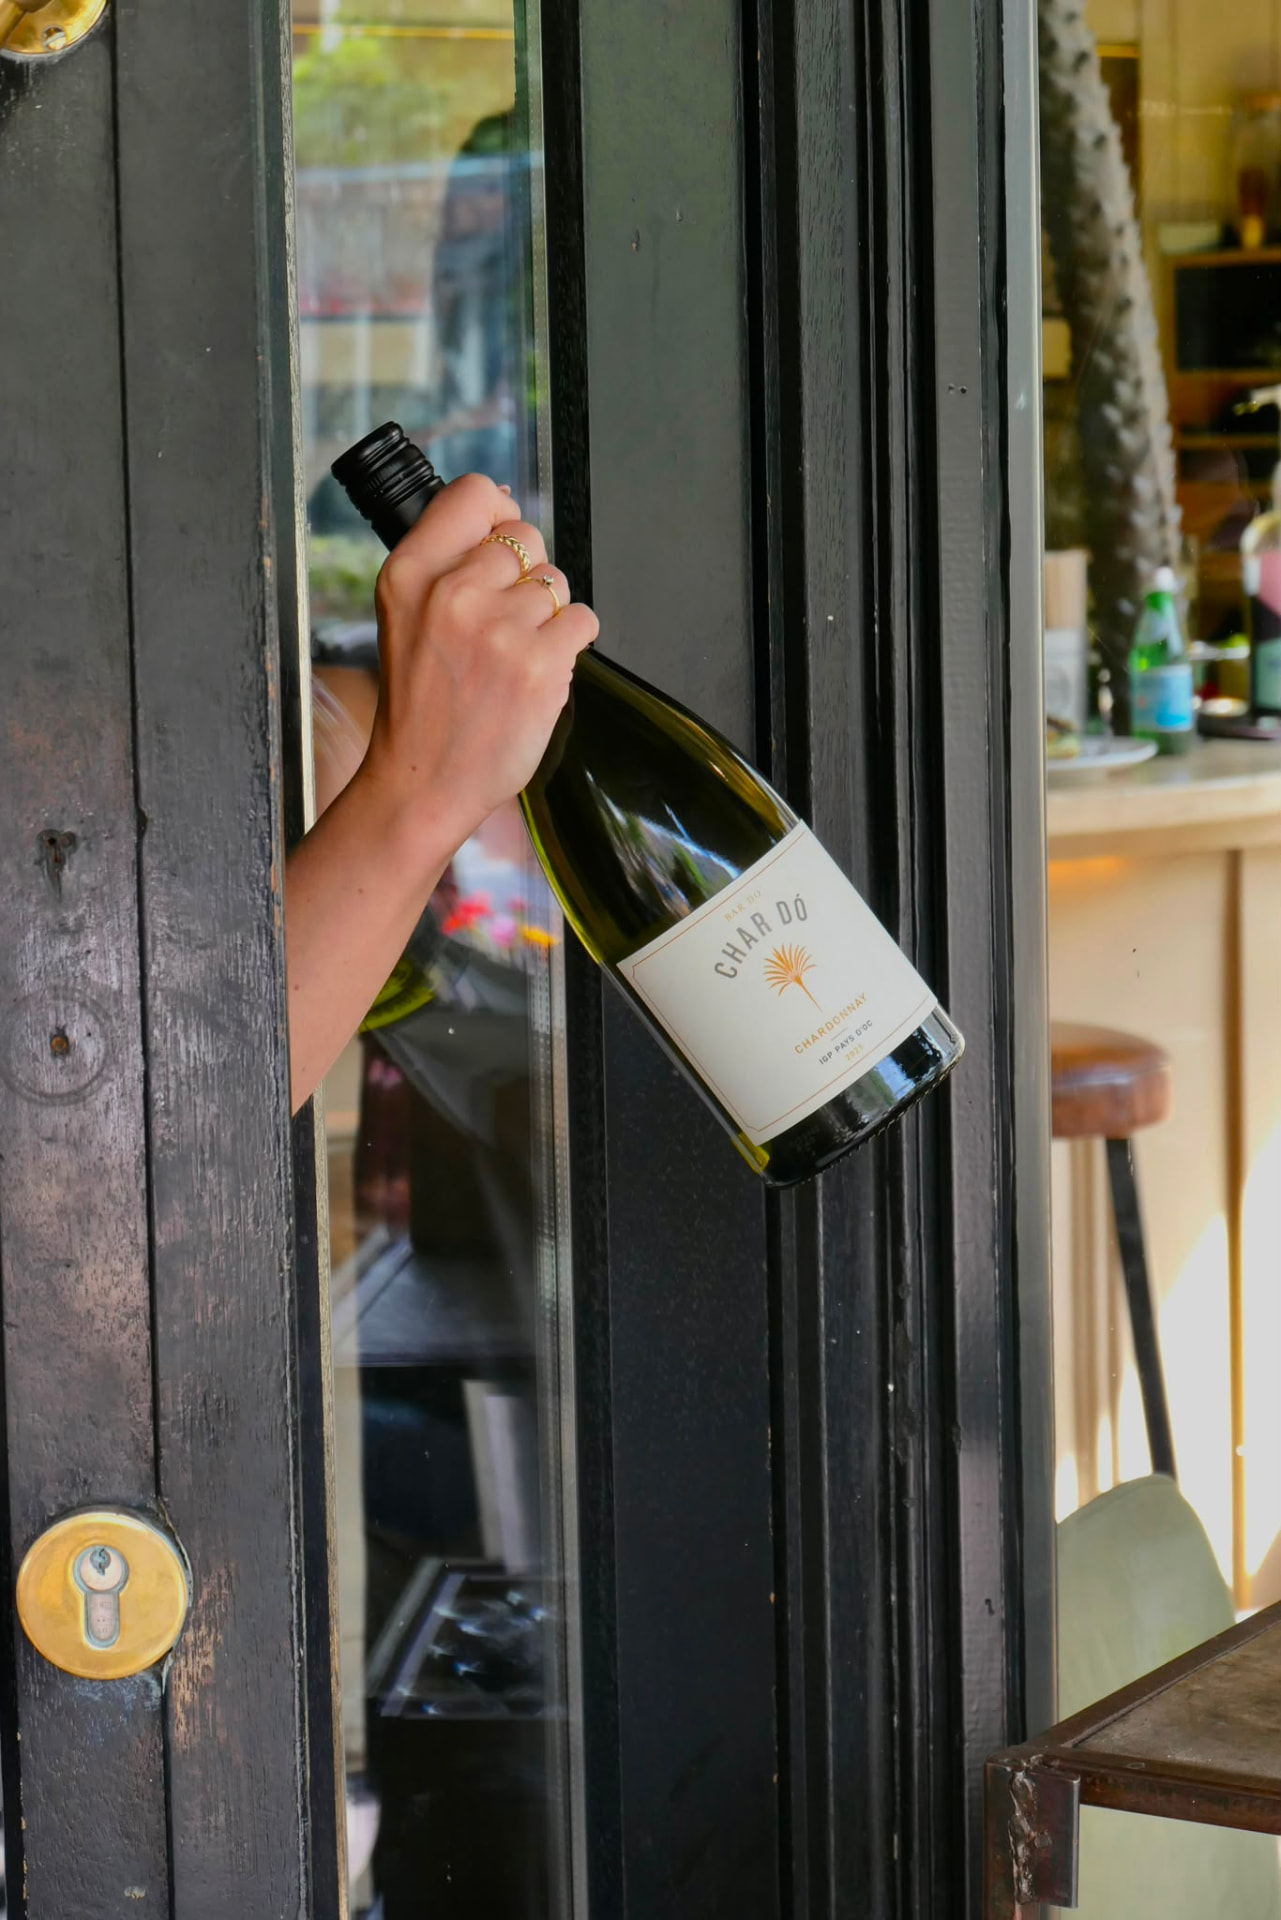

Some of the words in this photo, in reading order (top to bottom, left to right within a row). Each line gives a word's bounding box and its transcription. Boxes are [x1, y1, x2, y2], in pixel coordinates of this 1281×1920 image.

[714, 912, 773, 979] CHAR
[776, 893, 808, 925] DÓ
[794, 992, 867, 1054] CHARDONNAY
[819, 1051, 833, 1065] IGP
[834, 1034, 855, 1053] PAYS
